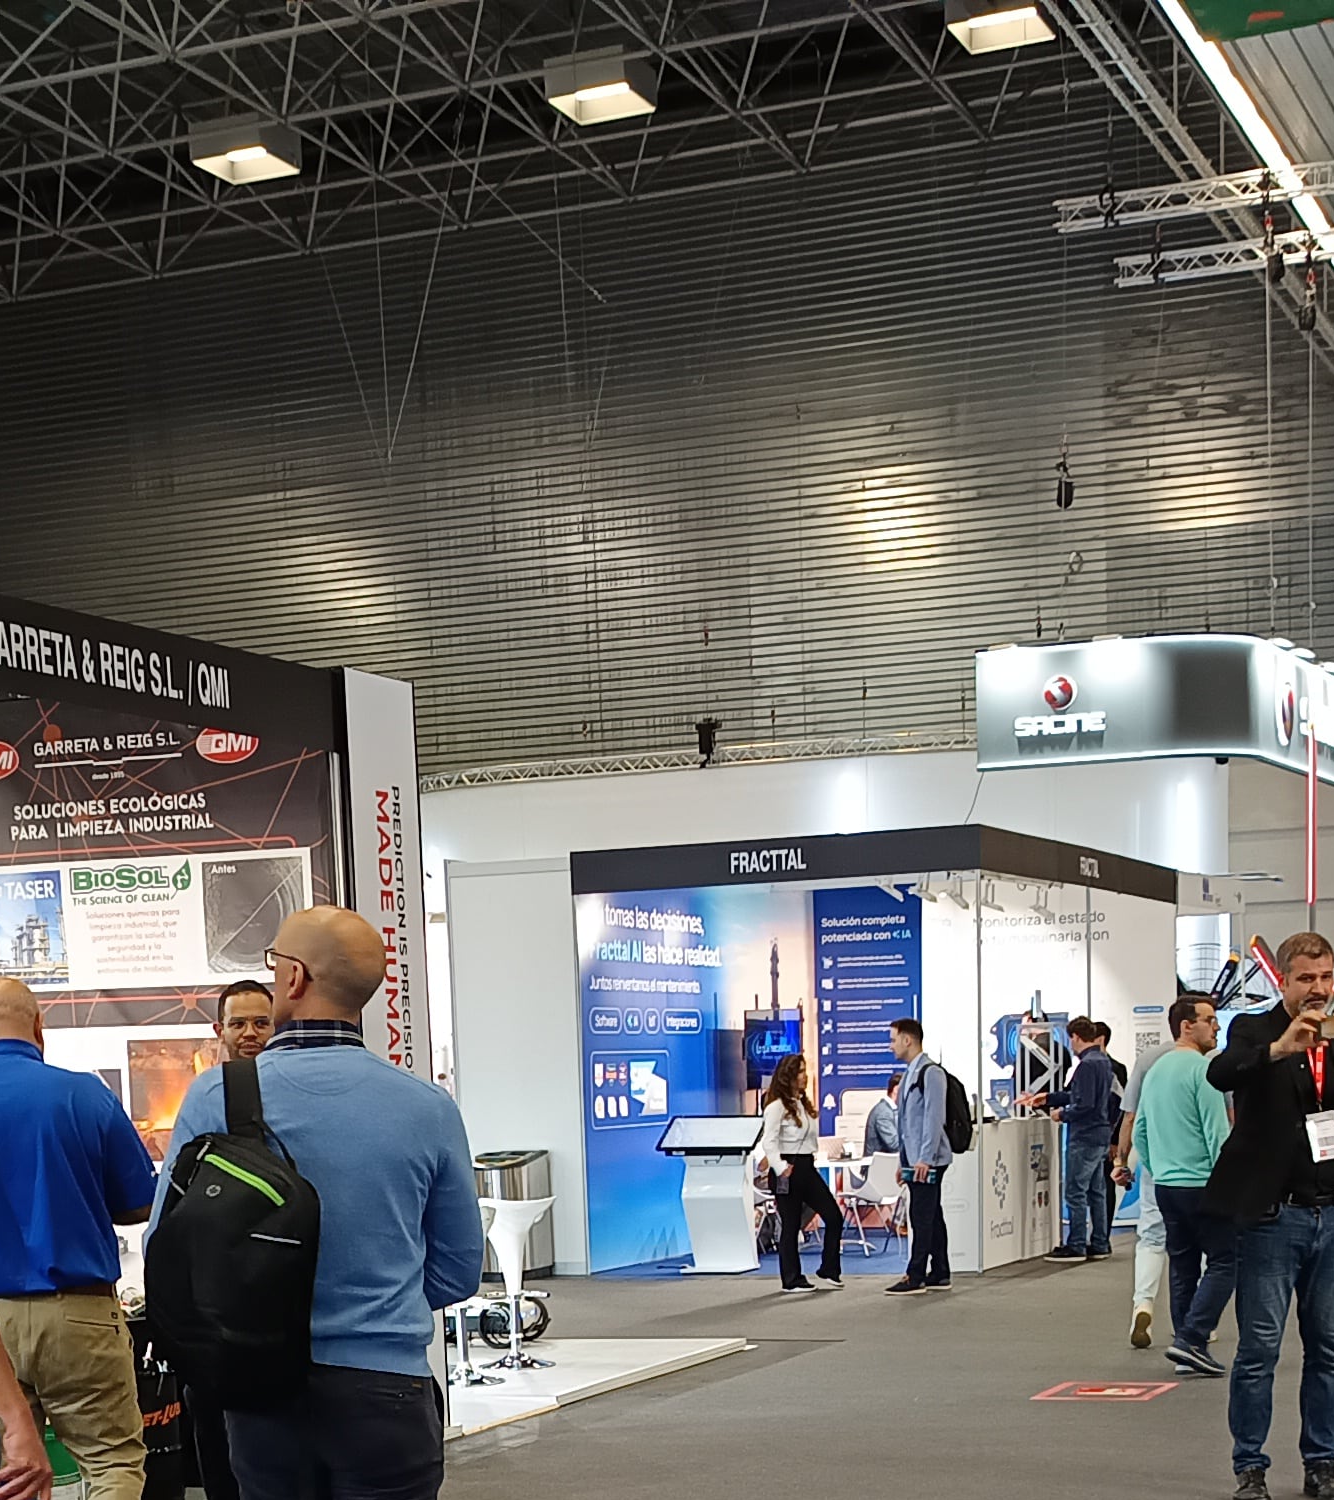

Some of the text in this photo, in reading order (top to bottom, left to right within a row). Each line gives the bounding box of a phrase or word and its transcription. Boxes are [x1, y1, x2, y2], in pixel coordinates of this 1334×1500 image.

[81, 638, 97, 684] &
[99, 641, 147, 693] REIG
[149, 652, 184, 701] S.L.
[197, 662, 231, 710] QMI
[33, 732, 182, 757] GARRETA & REIG S.L.
[210, 732, 253, 753] QMI
[13, 791, 206, 822] SOLUCIONES ECOLÓGICAS
[10, 812, 215, 842] PARA LIMPIEZA INDUSTRIAL
[375, 790, 395, 912] MADE
[730, 848, 808, 875] FRACTTAL
[210, 864, 237, 875] Antes
[4, 879, 56, 901] TASER
[72, 893, 170, 906] THE SCIENCE OF CLEAN
[391, 785, 414, 1072] PREDICTION IS PRECISIO
[604, 904, 705, 937] tomas las decisiones,
[820, 914, 906, 928] Solución completa
[1058, 911, 1106, 925] estado
[820, 929, 913, 945] potenciada con IA
[589, 939, 631, 963] racttal
[642, 942, 657, 965] las
